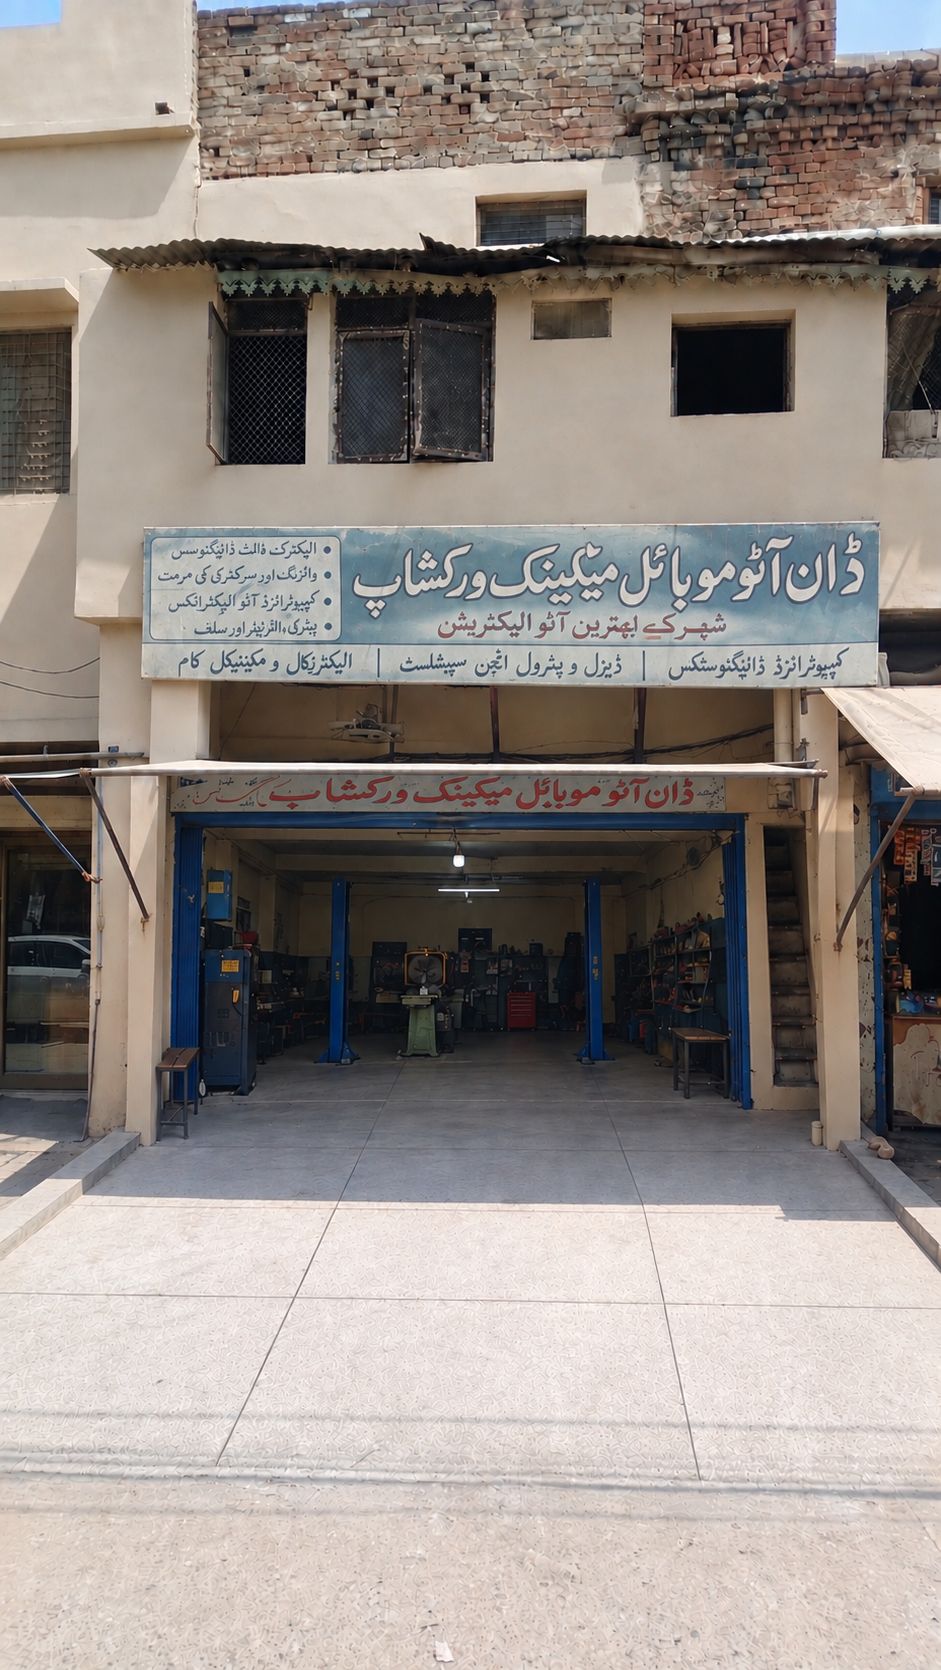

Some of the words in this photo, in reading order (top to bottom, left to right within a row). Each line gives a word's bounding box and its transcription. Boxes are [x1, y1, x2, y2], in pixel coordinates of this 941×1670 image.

[353, 543, 487, 619] ورکشاپ
[619, 543, 737, 612] موبائل
[730, 535, 794, 602] آٹو
[786, 532, 865, 603] ڈان
[534, 611, 571, 639] آٹو
[178, 649, 206, 676] کام
[269, 660, 279, 672] و
[570, 659, 578, 676] و
[602, 777, 649, 807] آٹو
[644, 777, 694, 809] ڈان
